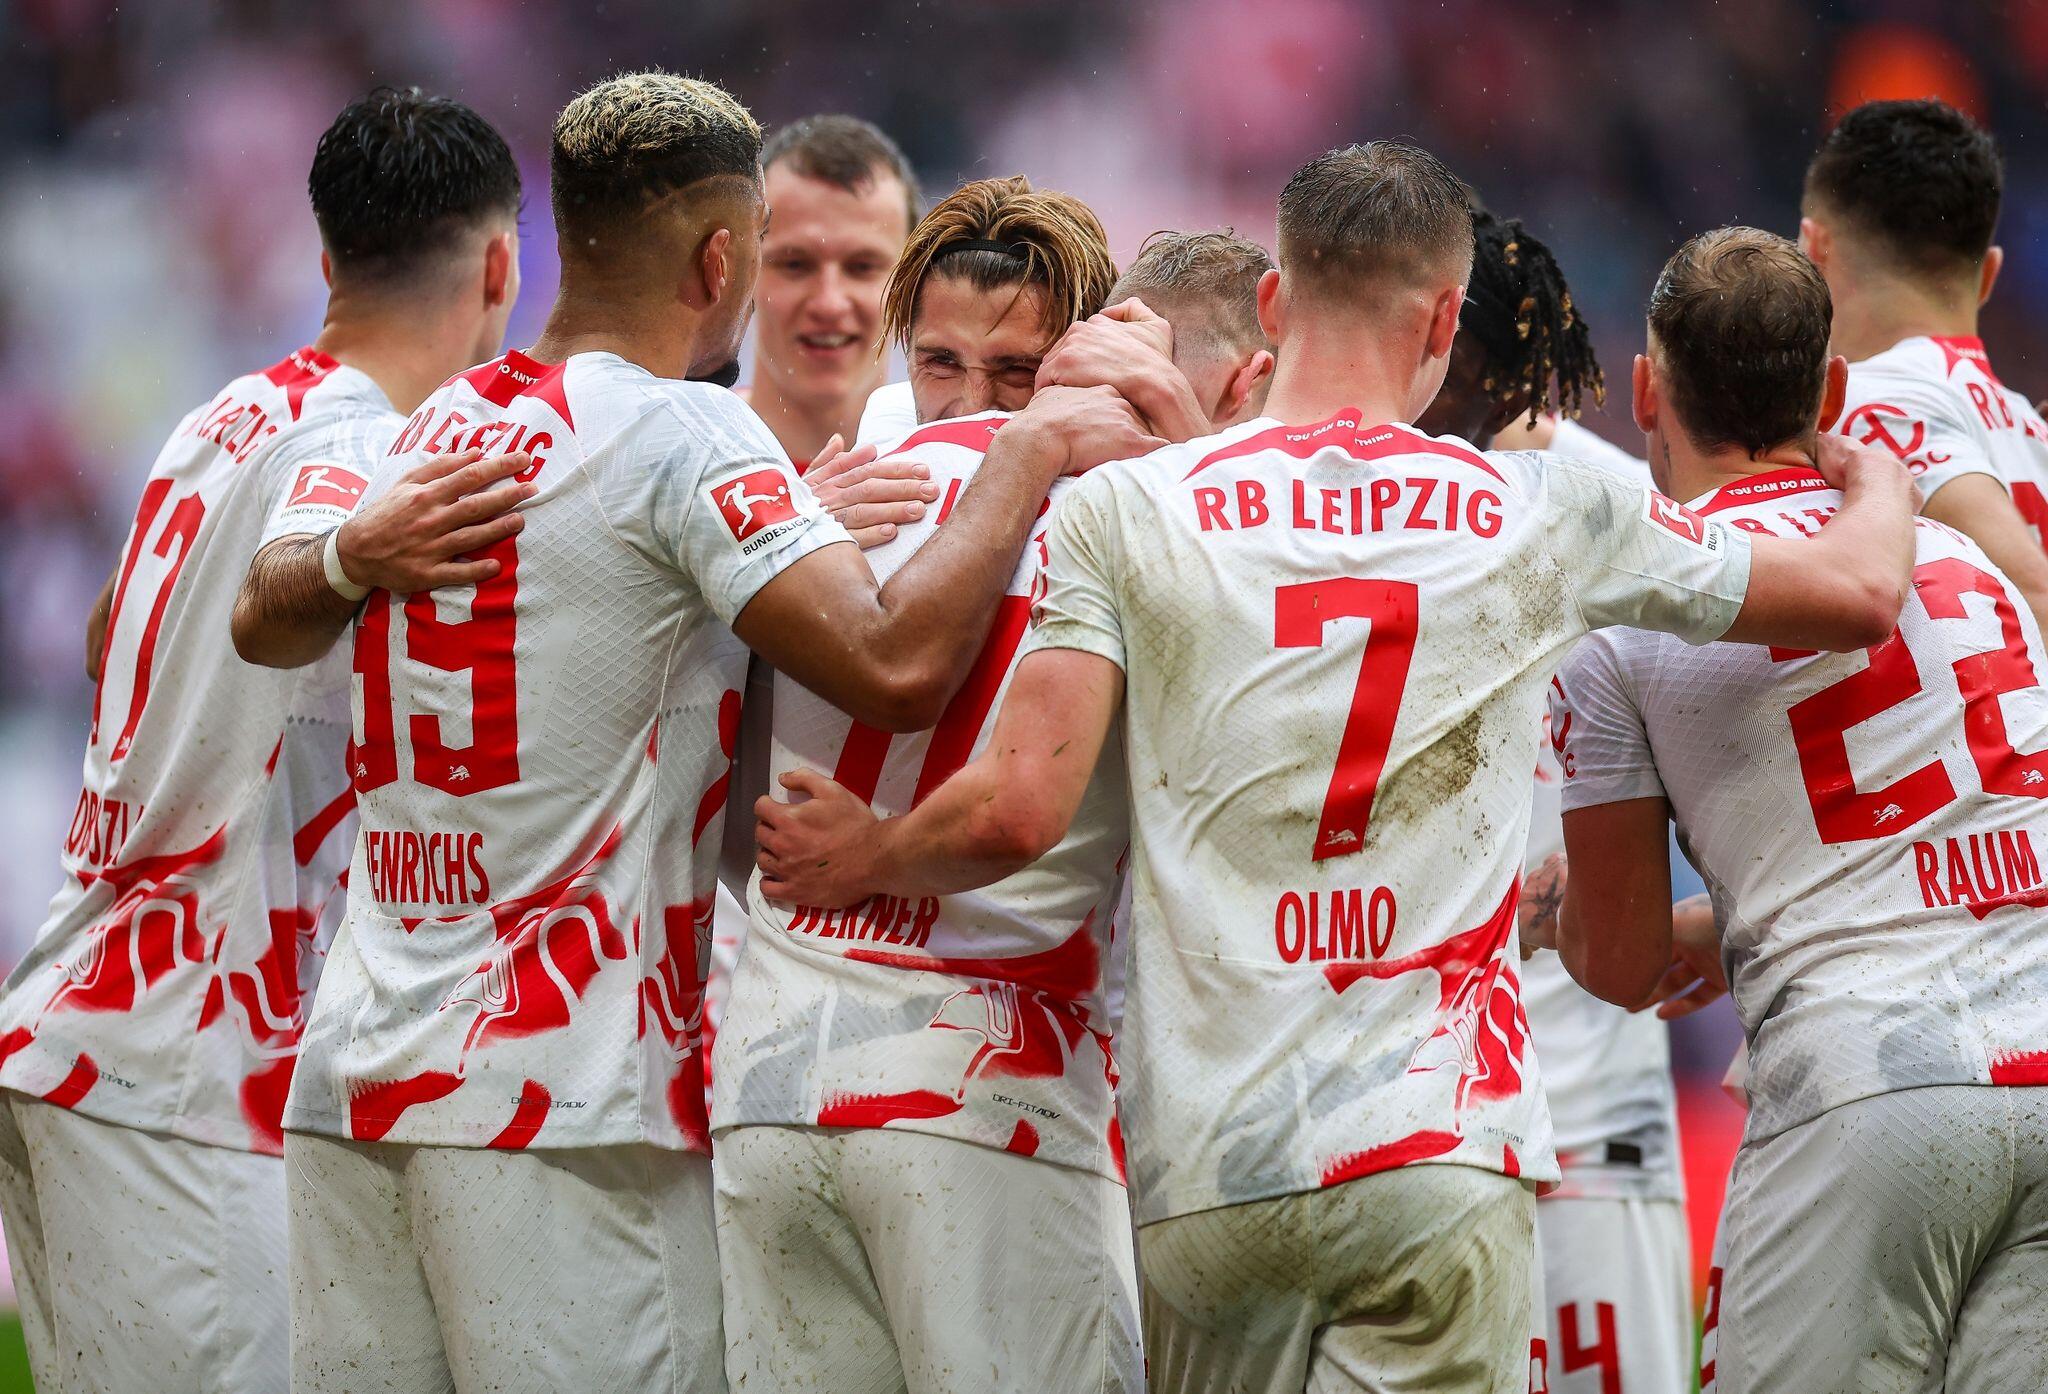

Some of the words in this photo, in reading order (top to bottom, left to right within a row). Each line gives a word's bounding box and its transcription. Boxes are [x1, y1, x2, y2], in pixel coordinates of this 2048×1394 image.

[1286, 433, 1310, 442] YOU
[1336, 419, 1355, 429] DO
[1193, 480, 1270, 532] RB
[1292, 476, 1504, 539] LEIPZIG
[1753, 483, 1778, 493] CAN
[1780, 480, 1797, 489] DO
[742, 516, 811, 556] BUNDESLIGA
[1273, 577, 1419, 862] 7
[1768, 557, 2048, 845] 22
[363, 830, 490, 905] ENRICHS
[1912, 829, 2042, 908] RAUM
[1275, 885, 1397, 964] OLMO
